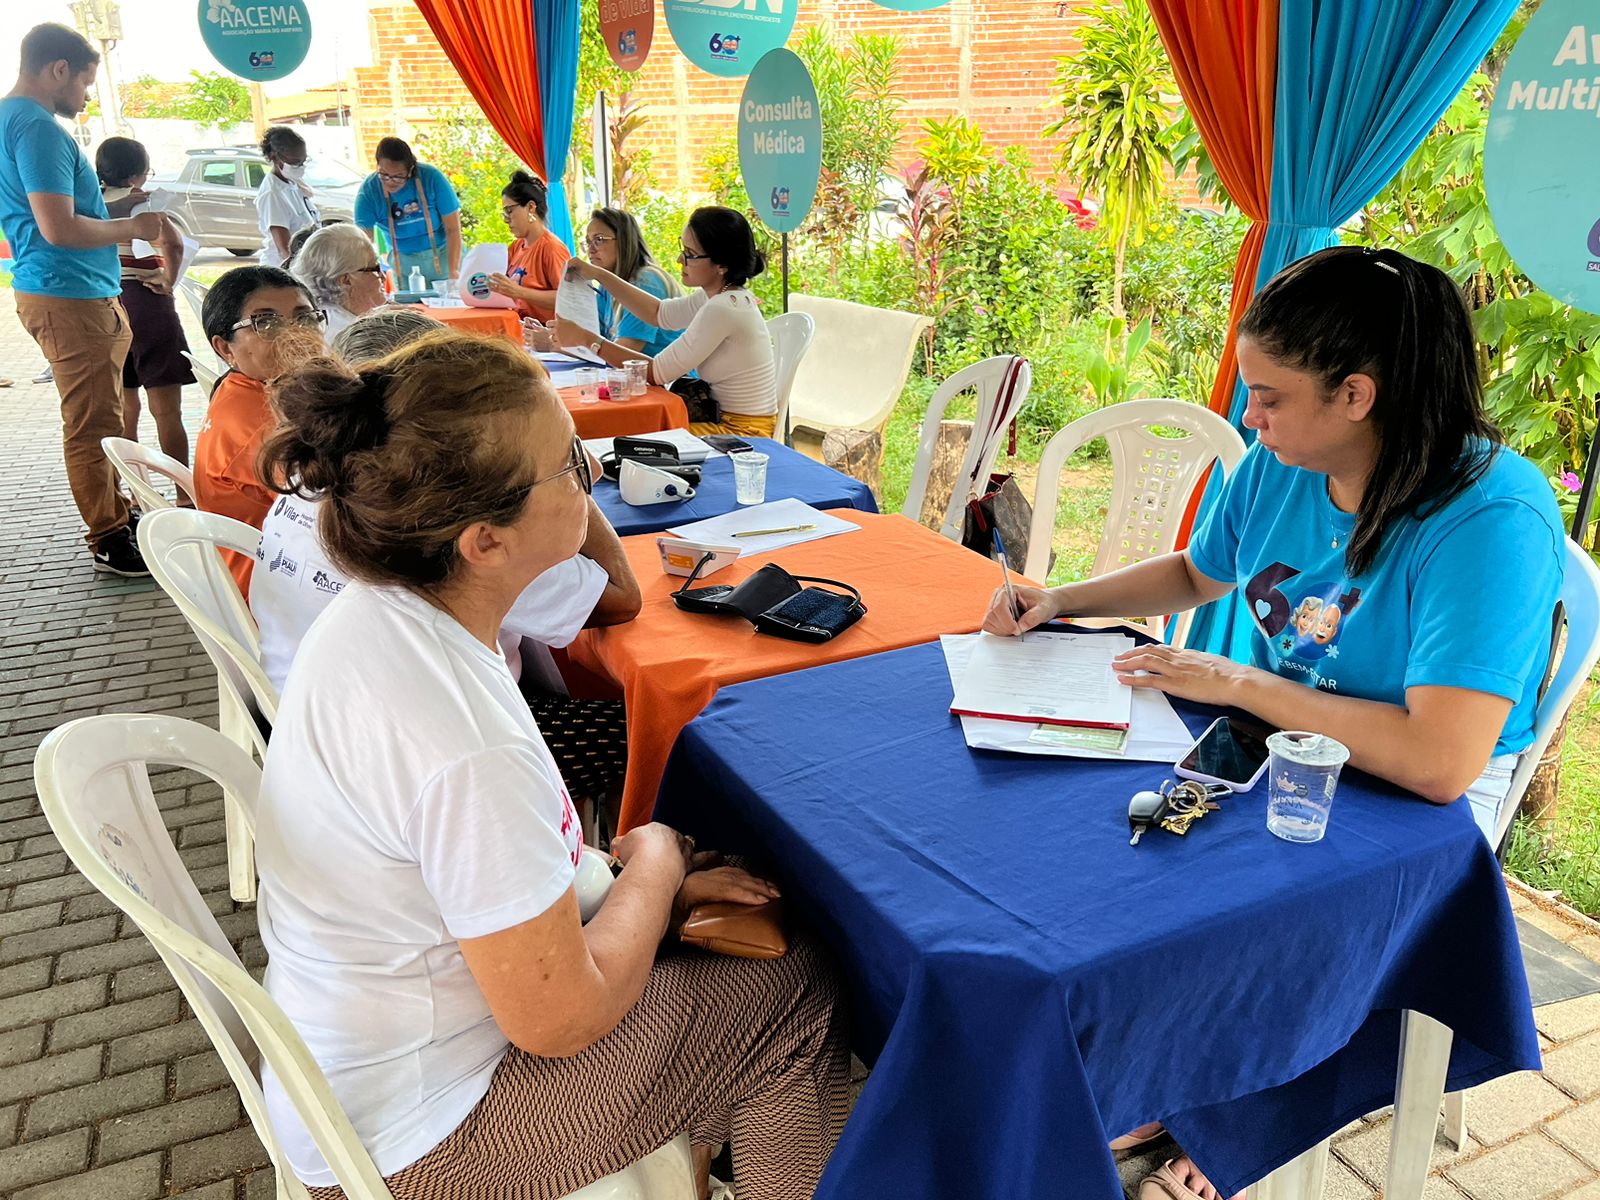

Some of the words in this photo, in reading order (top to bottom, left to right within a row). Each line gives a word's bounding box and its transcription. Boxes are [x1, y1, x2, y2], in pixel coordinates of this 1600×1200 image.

[220, 5, 302, 28] AACEMA
[745, 95, 812, 123] Consulta
[1507, 77, 1600, 118] Multi
[753, 129, 805, 155] Médica
[284, 505, 299, 522] Vilar
[316, 577, 346, 592] AACE
